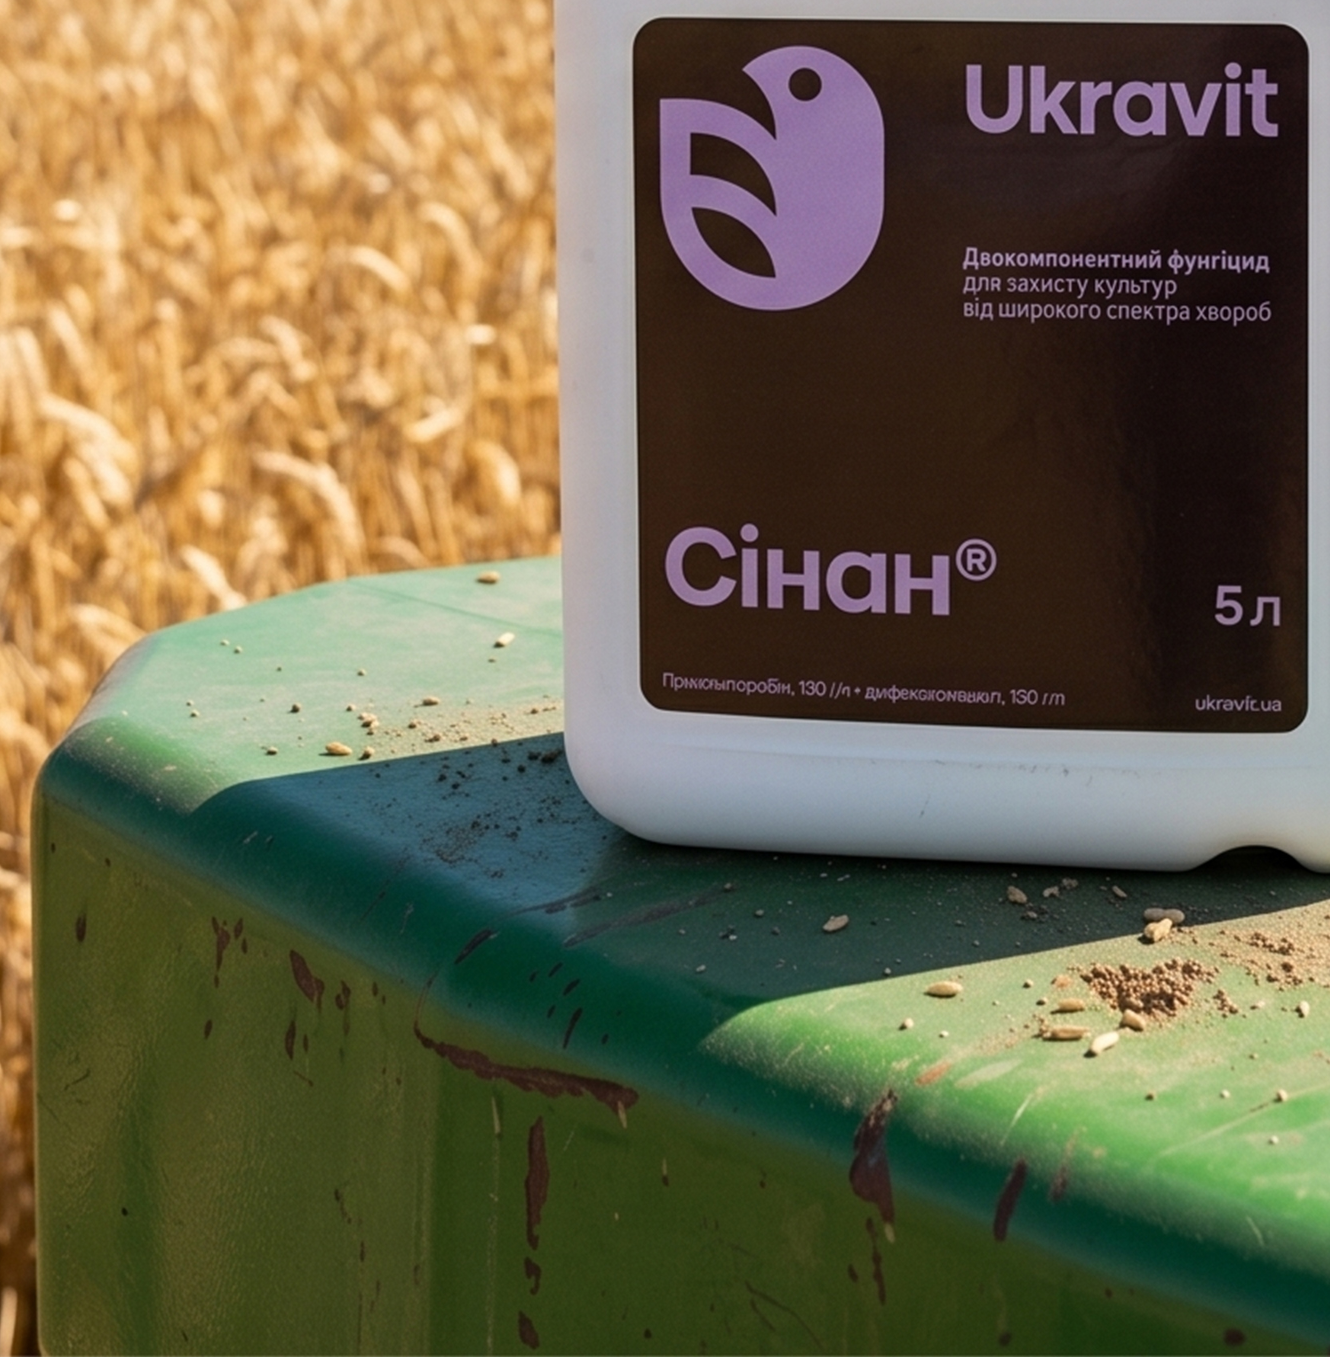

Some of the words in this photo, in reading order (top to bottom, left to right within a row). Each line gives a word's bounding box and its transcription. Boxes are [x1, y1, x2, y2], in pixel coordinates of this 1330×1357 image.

[966, 62, 1279, 137] Ukravit
[962, 246, 1162, 271] Двокомпонентний
[1167, 248, 1271, 276] фунгіцид
[1006, 276, 1089, 299] захисту
[1094, 278, 1178, 301] культур
[963, 297, 994, 321] від
[998, 302, 1101, 324] широкого
[1106, 304, 1191, 326] спектра
[1195, 300, 1272, 327] хвороб
[1214, 585, 1244, 627] 5
[1249, 596, 1282, 628] л
